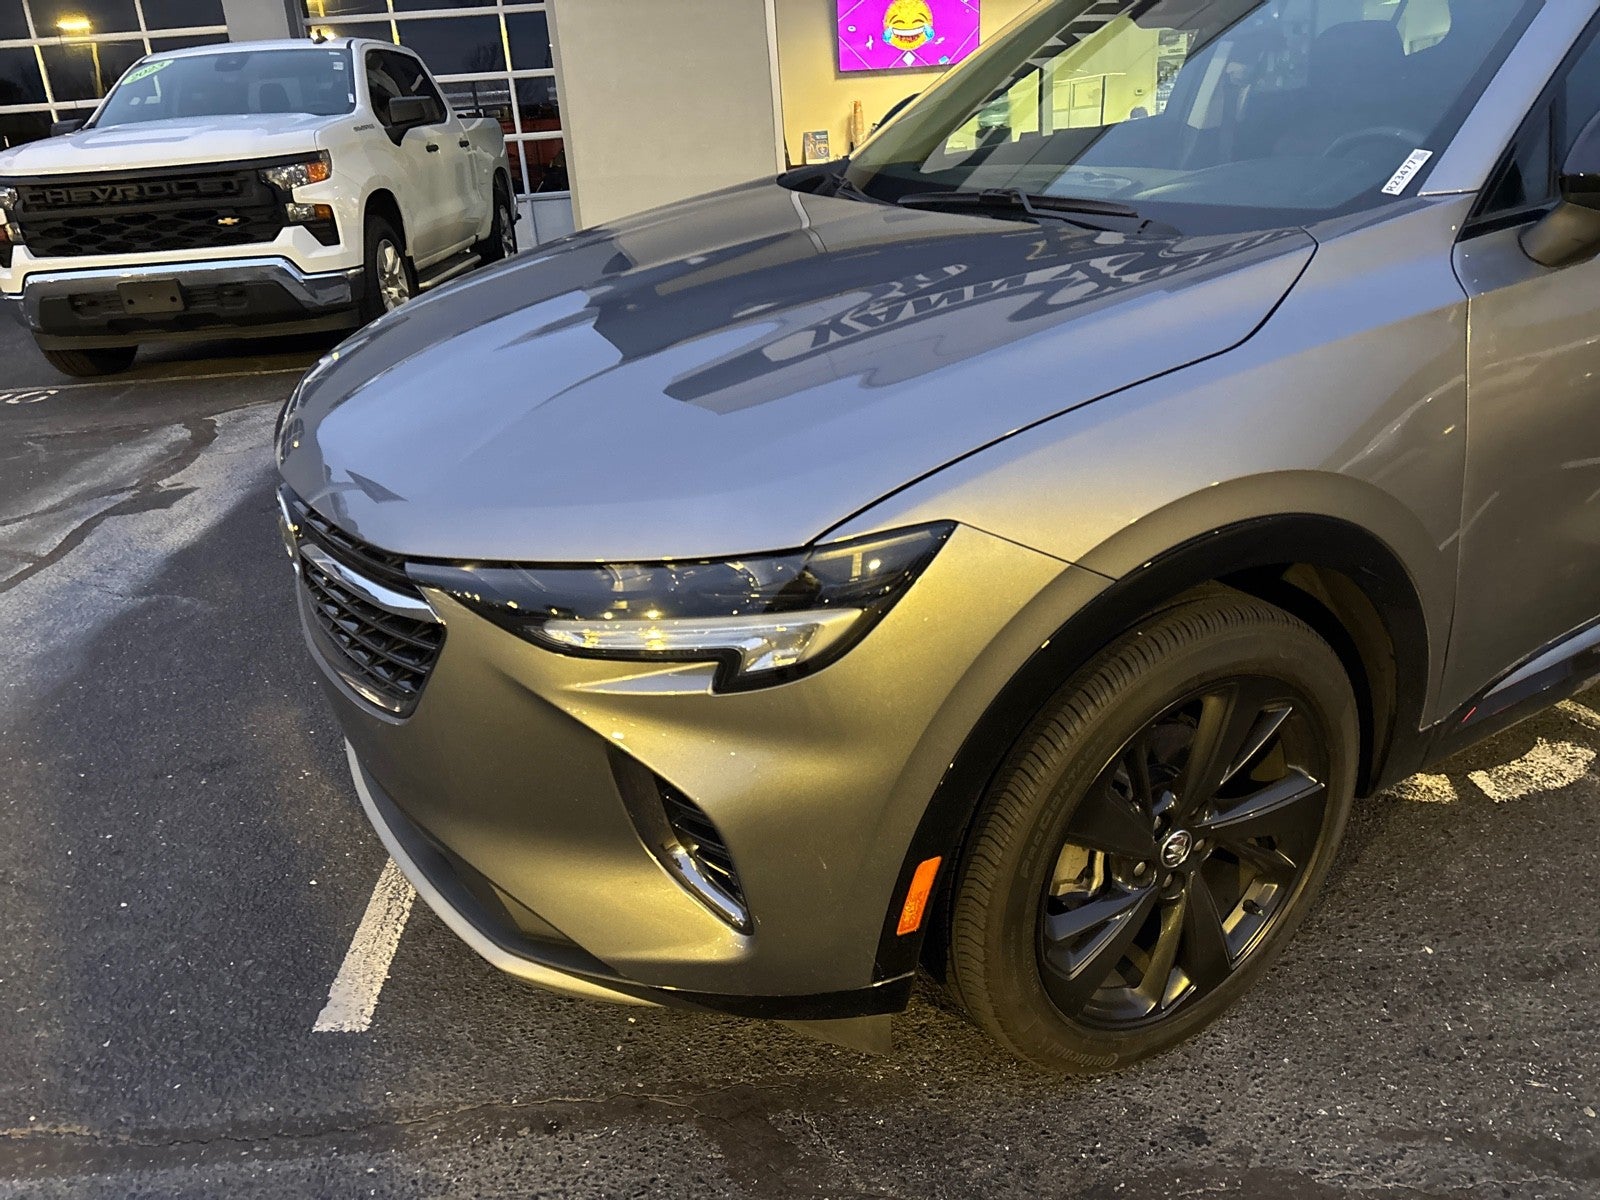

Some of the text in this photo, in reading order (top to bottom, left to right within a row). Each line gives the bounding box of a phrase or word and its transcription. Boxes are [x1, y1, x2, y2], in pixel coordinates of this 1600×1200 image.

[130, 61, 165, 81] 2023
[1386, 159, 1417, 192] R23477
[25, 178, 249, 205] CHEVROLET
